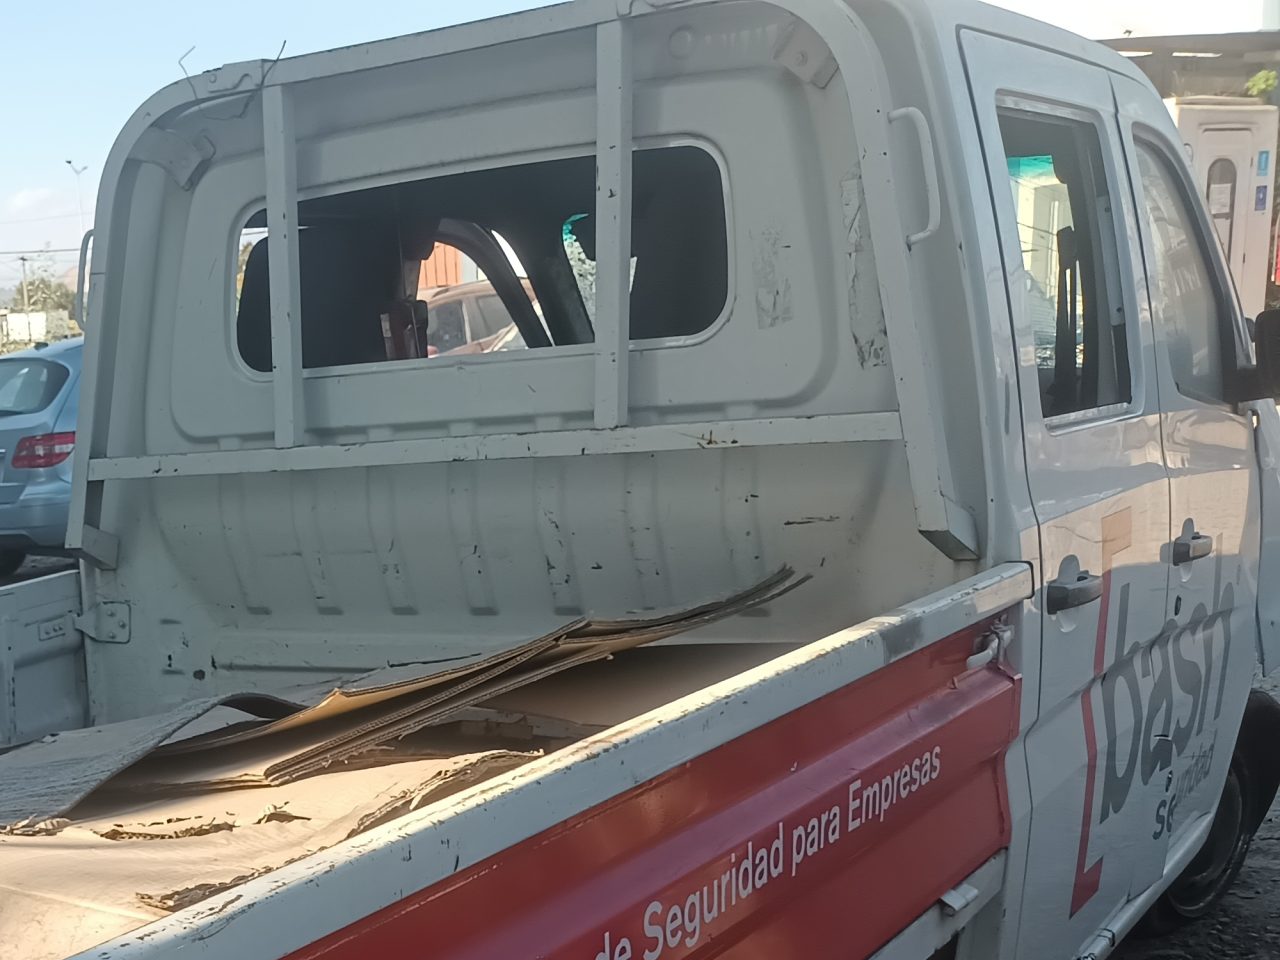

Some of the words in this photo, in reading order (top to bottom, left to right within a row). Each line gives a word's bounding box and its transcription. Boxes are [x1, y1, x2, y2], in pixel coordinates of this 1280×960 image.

[1100, 533, 1235, 825] bash
[792, 803, 840, 877] para
[848, 744, 942, 833] Empresas
